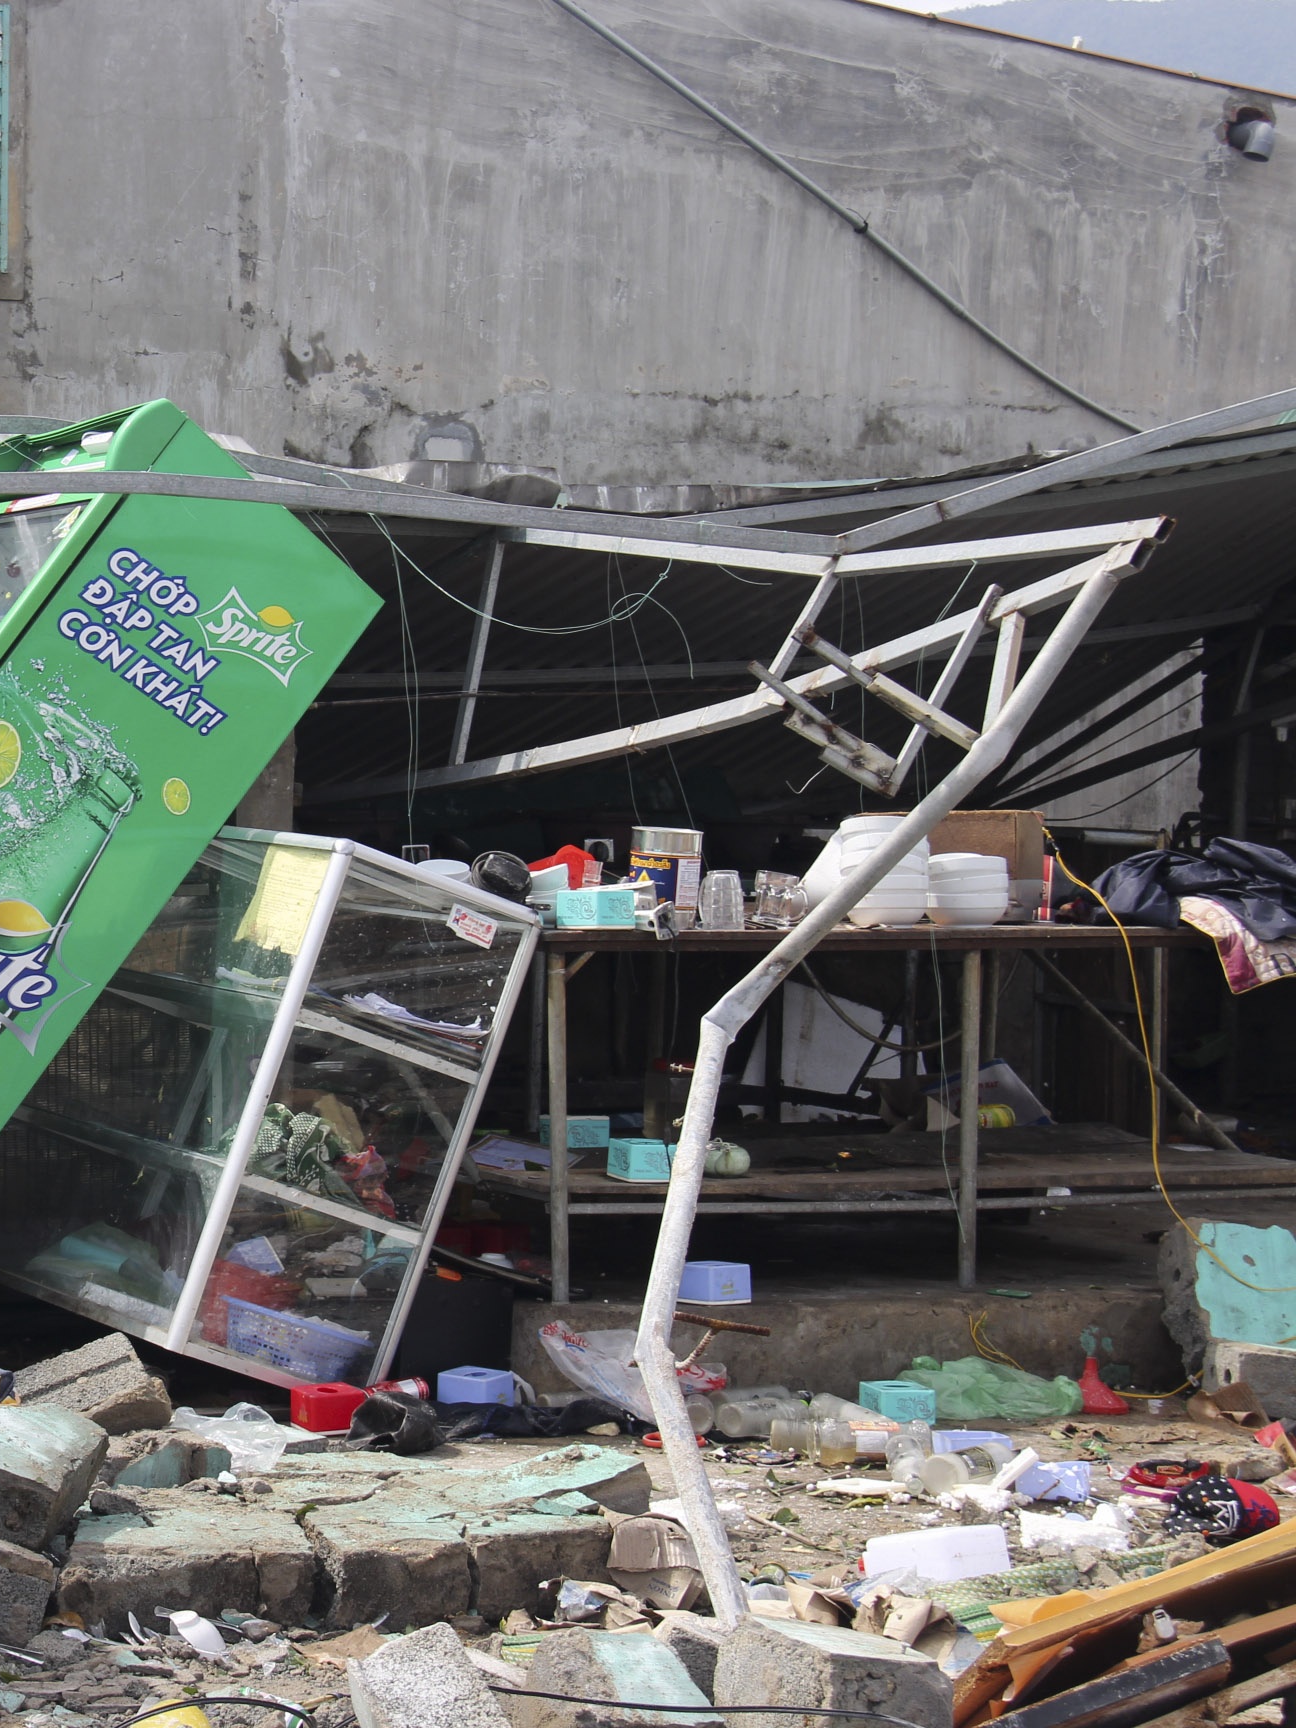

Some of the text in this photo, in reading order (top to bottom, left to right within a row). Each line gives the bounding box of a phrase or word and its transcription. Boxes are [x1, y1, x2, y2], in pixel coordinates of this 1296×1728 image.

[108, 549, 198, 616] CHỚP
[80, 576, 221, 682] ĐẬP TAN
[204, 607, 298, 664] Sprite
[59, 611, 227, 735] CƠN KHÁT!
